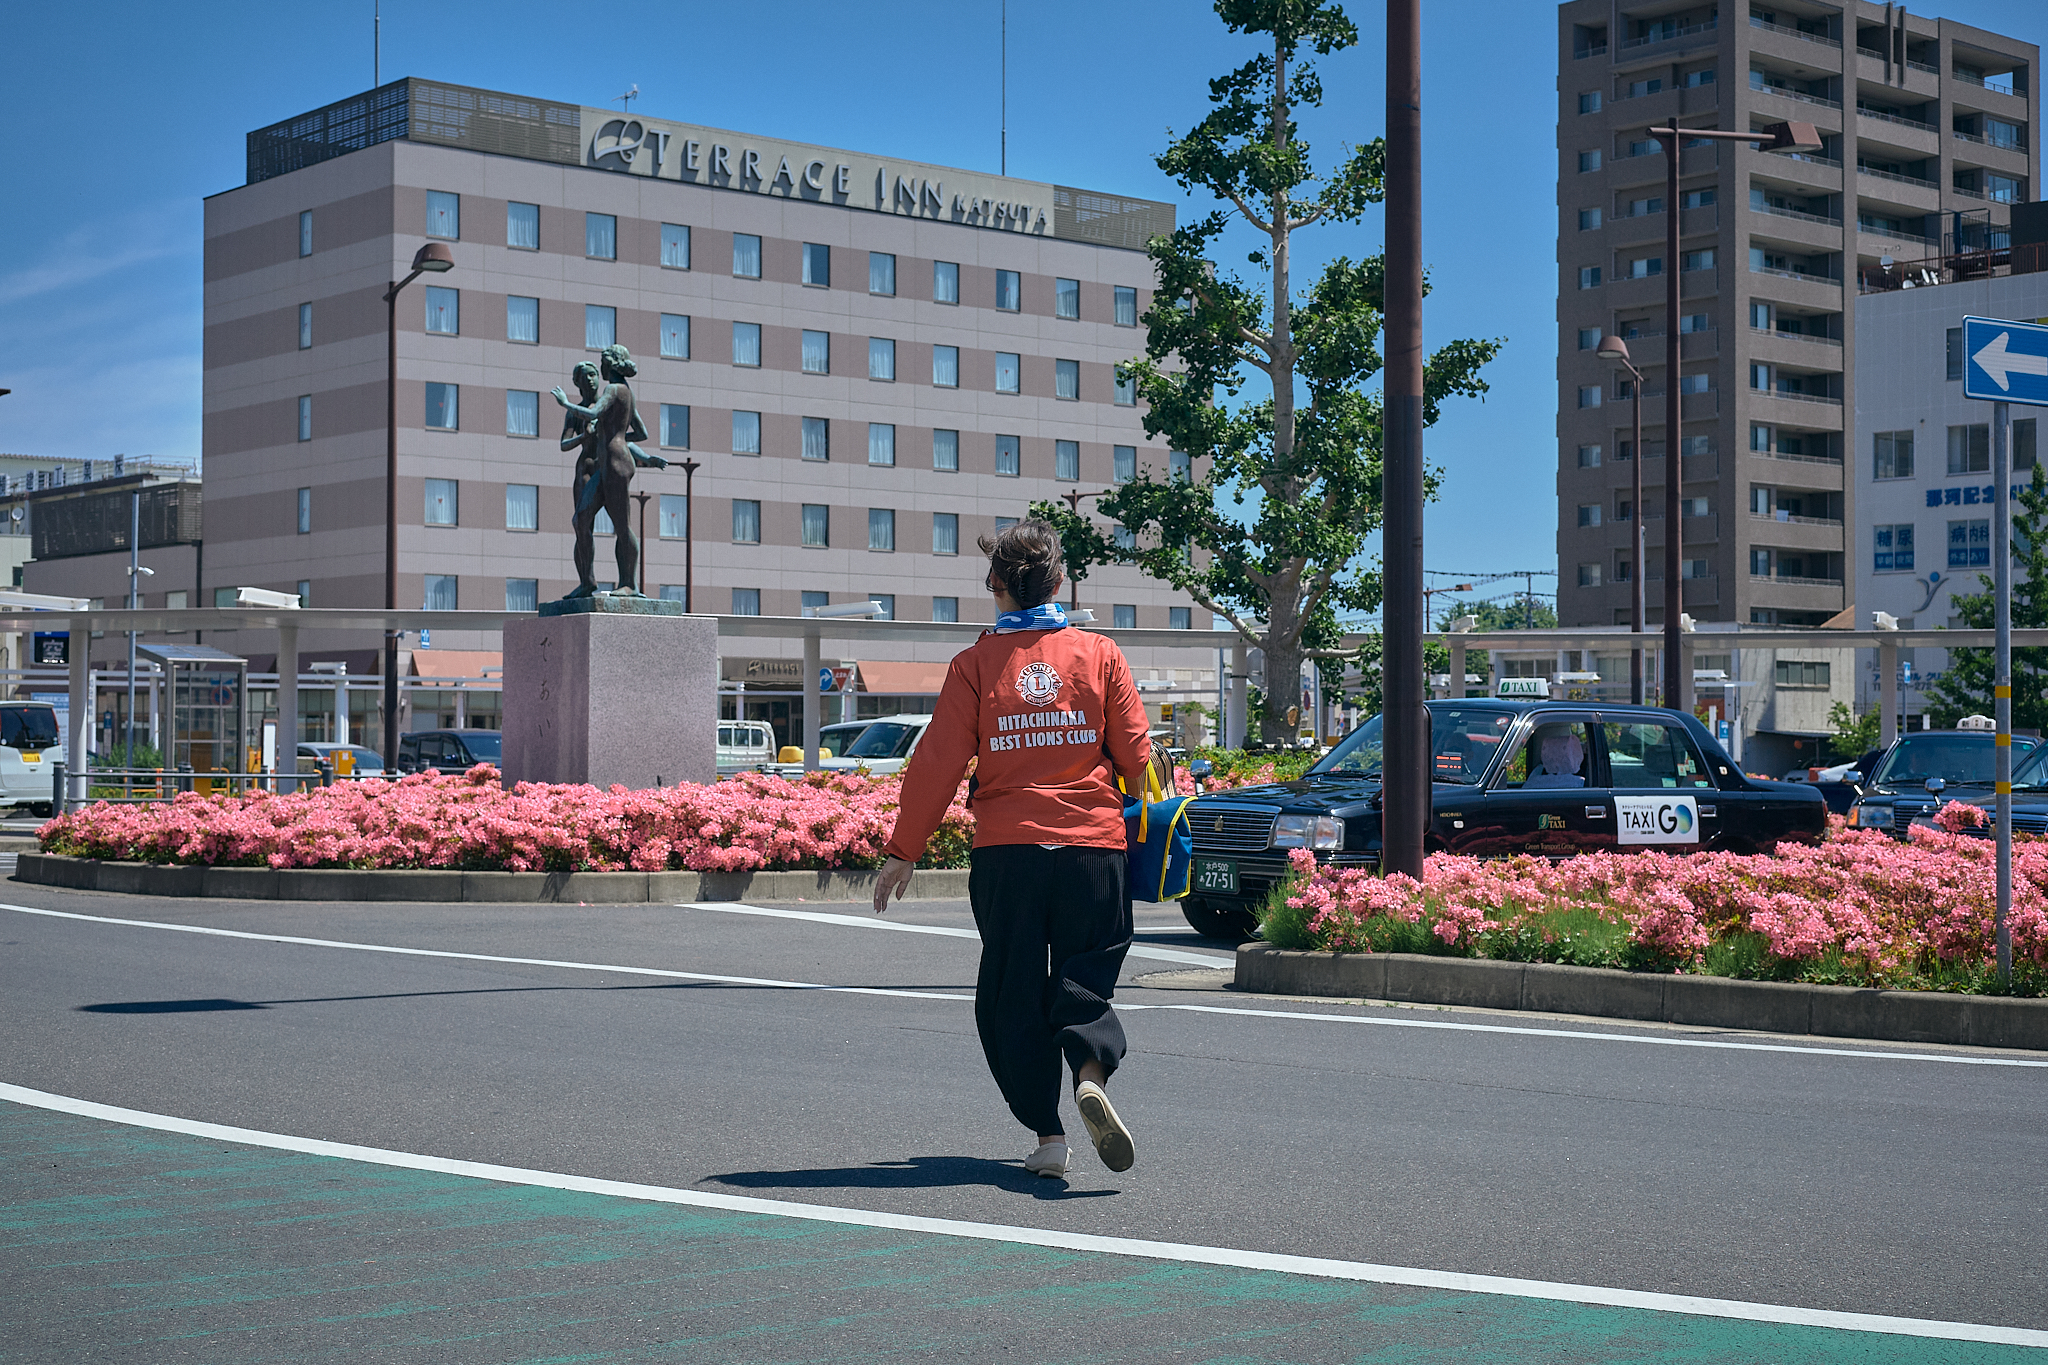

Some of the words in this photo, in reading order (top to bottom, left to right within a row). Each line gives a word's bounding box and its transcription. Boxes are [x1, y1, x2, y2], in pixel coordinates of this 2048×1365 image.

[649, 128, 850, 194] TERRACE
[880, 167, 943, 208] INN
[955, 194, 1047, 225] KATSUTA
[763, 661, 800, 671] TERRACE
[1023, 664, 1052, 676] LIONS
[1033, 676, 1047, 691] L
[1511, 681, 1537, 692] TAXI
[997, 710, 1087, 731] HITACHINAKA
[989, 734, 1021, 752] BEST
[1024, 731, 1064, 748] LIONS
[1066, 729, 1097, 745] CLUB
[1548, 820, 1566, 828] TAXI
[1622, 811, 1655, 828] TAXI
[1658, 804, 1693, 834] GO
[1540, 842, 1561, 851] Transport
[1561, 842, 1576, 851] Group
